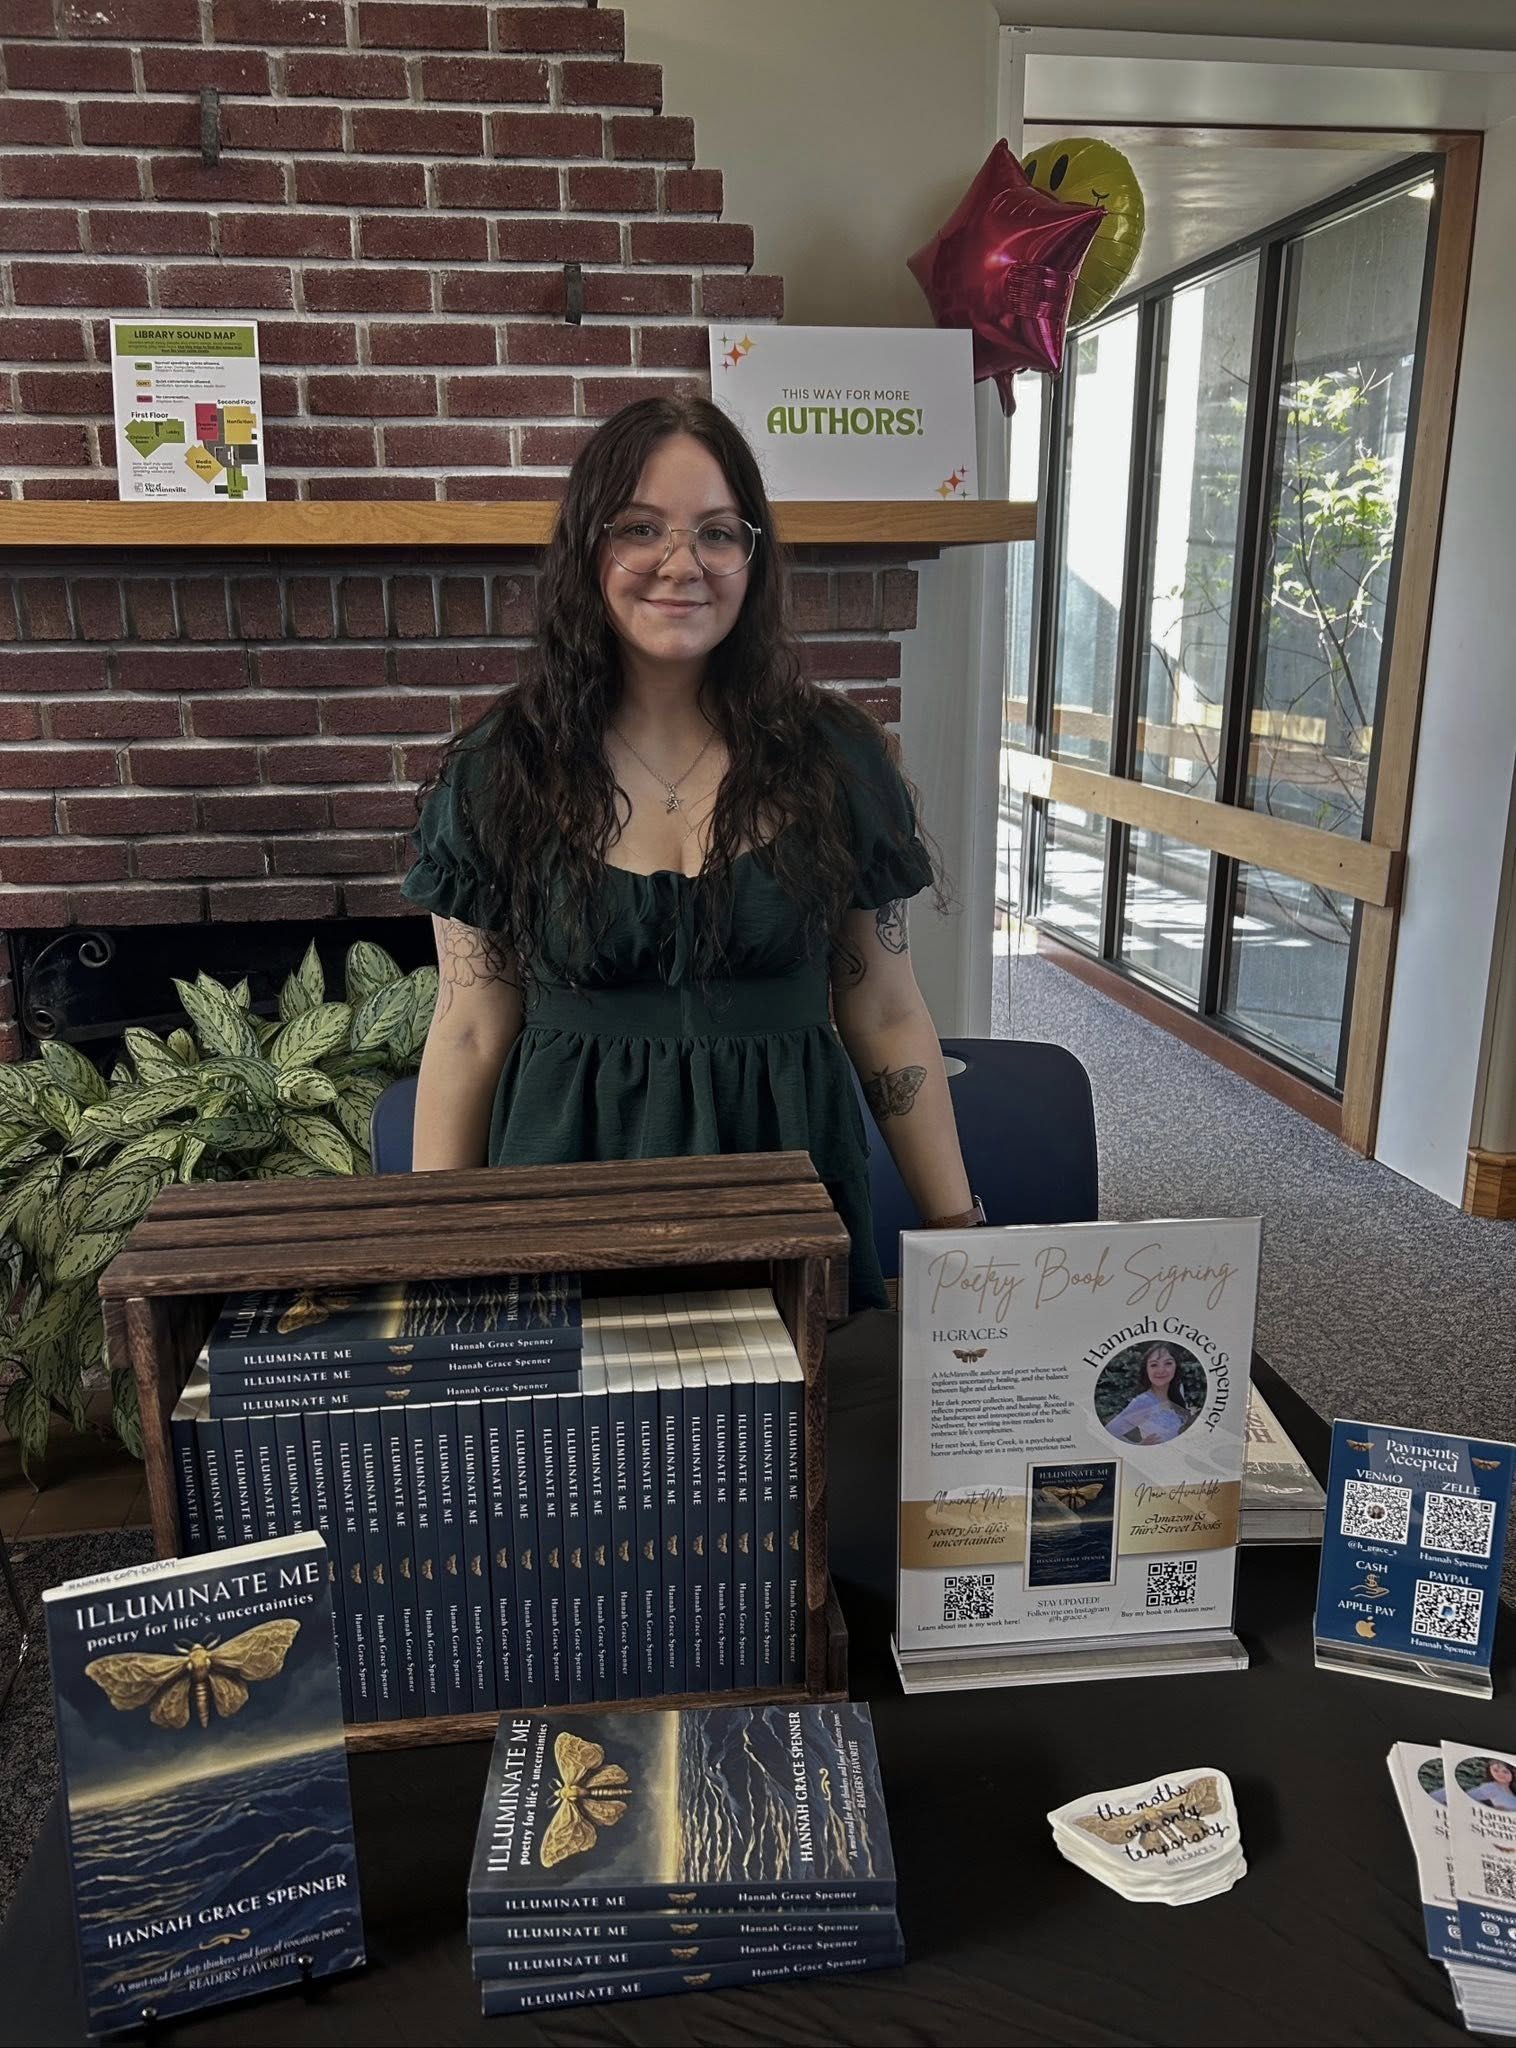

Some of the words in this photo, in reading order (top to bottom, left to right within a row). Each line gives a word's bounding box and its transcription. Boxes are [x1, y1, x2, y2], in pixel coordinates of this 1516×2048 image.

[135, 331, 174, 339] LIBRARY
[177, 331, 211, 339] SOUND
[782, 389, 809, 399] THIS
[814, 389, 842, 399] WAY
[847, 390, 870, 400] FOR
[875, 391, 909, 400] MORE
[767, 407, 924, 435] AUTHORS!
[928, 1249, 1027, 1323] Poetry
[1035, 1246, 1114, 1310] Book
[1124, 1243, 1239, 1312] Signing
[932, 1328, 1008, 1342] H.GRACE.S
[243, 1350, 329, 1365] ILLUMINATE
[333, 1349, 352, 1359] ME
[450, 1341, 485, 1351] Hannah
[488, 1339, 514, 1349] Grace
[517, 1337, 554, 1348] Spenner
[243, 1371, 328, 1387] ILLUMINATE
[332, 1370, 351, 1380] ME
[448, 1361, 482, 1371] Hannah
[485, 1358, 512, 1369] Grace
[515, 1356, 551, 1367] Spenner
[1082, 1315, 1158, 1369] Hannah
[1163, 1316, 1217, 1354] Grace
[1204, 1352, 1231, 1433] Spenner
[764, 1413, 772, 1483] ILLUMINATE
[1386, 1439, 1459, 1461] Payments
[1384, 1452, 1458, 1473] Accepted
[1356, 1468, 1403, 1484] VENMO
[1442, 1482, 1480, 1496] ZELLE
[234, 1449, 251, 1520] ILLUMINATE
[243, 1525, 253, 1540] ME
[764, 1487, 772, 1502] ME
[1130, 1525, 1159, 1535] Third
[1158, 1524, 1190, 1534] Street
[1192, 1520, 1222, 1531] Books
[1145, 1514, 1193, 1524] Amazon
[1195, 1511, 1206, 1520] &
[928, 1527, 965, 1539] poetry
[964, 1524, 984, 1536] for
[933, 1535, 1006, 1547] uncertainties
[1347, 1540, 1398, 1555] @h_grace_s
[1356, 1560, 1388, 1573] CASH
[1420, 1552, 1452, 1565] Hannah
[1454, 1557, 1488, 1571] Spenner
[1429, 1571, 1472, 1586] PAYPAL
[76, 1572, 268, 1631] ILLUMINATE
[279, 1562, 320, 1590] ME
[764, 1581, 772, 1609] Hannah
[764, 1611, 772, 1631] Grace
[1027, 1609, 1049, 1617] Follow
[1337, 1600, 1373, 1614] APPLE
[1375, 1605, 1397, 1617] PAY
[86, 1628, 140, 1652] poetry
[145, 1622, 168, 1637] for
[173, 1612, 211, 1631] life's
[217, 1594, 314, 1621] uncertainties
[764, 1635, 772, 1664] Spenner
[1411, 1637, 1442, 1650] Hannah
[1444, 1643, 1477, 1657] Spenner
[789, 1711, 804, 1758] SPENNER
[533, 1724, 548, 1780] uncertainties
[849, 1740, 860, 1773] FAVORITE
[794, 1760, 808, 1801] GRACE
[487, 1748, 526, 1872] ILLUMINATE
[510, 1719, 531, 1742] ME
[525, 1783, 539, 1807] life's
[1094, 1803, 1132, 1823] the
[1136, 1783, 1190, 1810] moths
[522, 1812, 535, 1826] for
[1125, 1822, 1155, 1840] are
[1161, 1804, 1202, 1827] only
[797, 1804, 813, 1862] HANNAH
[1122, 1823, 1230, 1862] temporary
[520, 1830, 535, 1865] poetry
[107, 1914, 192, 1950] HANNAH
[198, 1895, 261, 1924] GRACE
[266, 1873, 348, 1907] SPENNER
[505, 1897, 599, 1910] ILLUMINATE
[605, 1896, 626, 1906] ME
[739, 1892, 778, 1902] Hannah
[781, 1891, 811, 1901] Grace
[815, 1889, 857, 1901] Spenner
[520, 1985, 614, 2006] ILLUMINATE
[621, 1983, 641, 1994] ME
[752, 1967, 790, 1978] Hannah
[793, 1962, 823, 1974] Grace
[825, 1957, 867, 1971] Spenner
